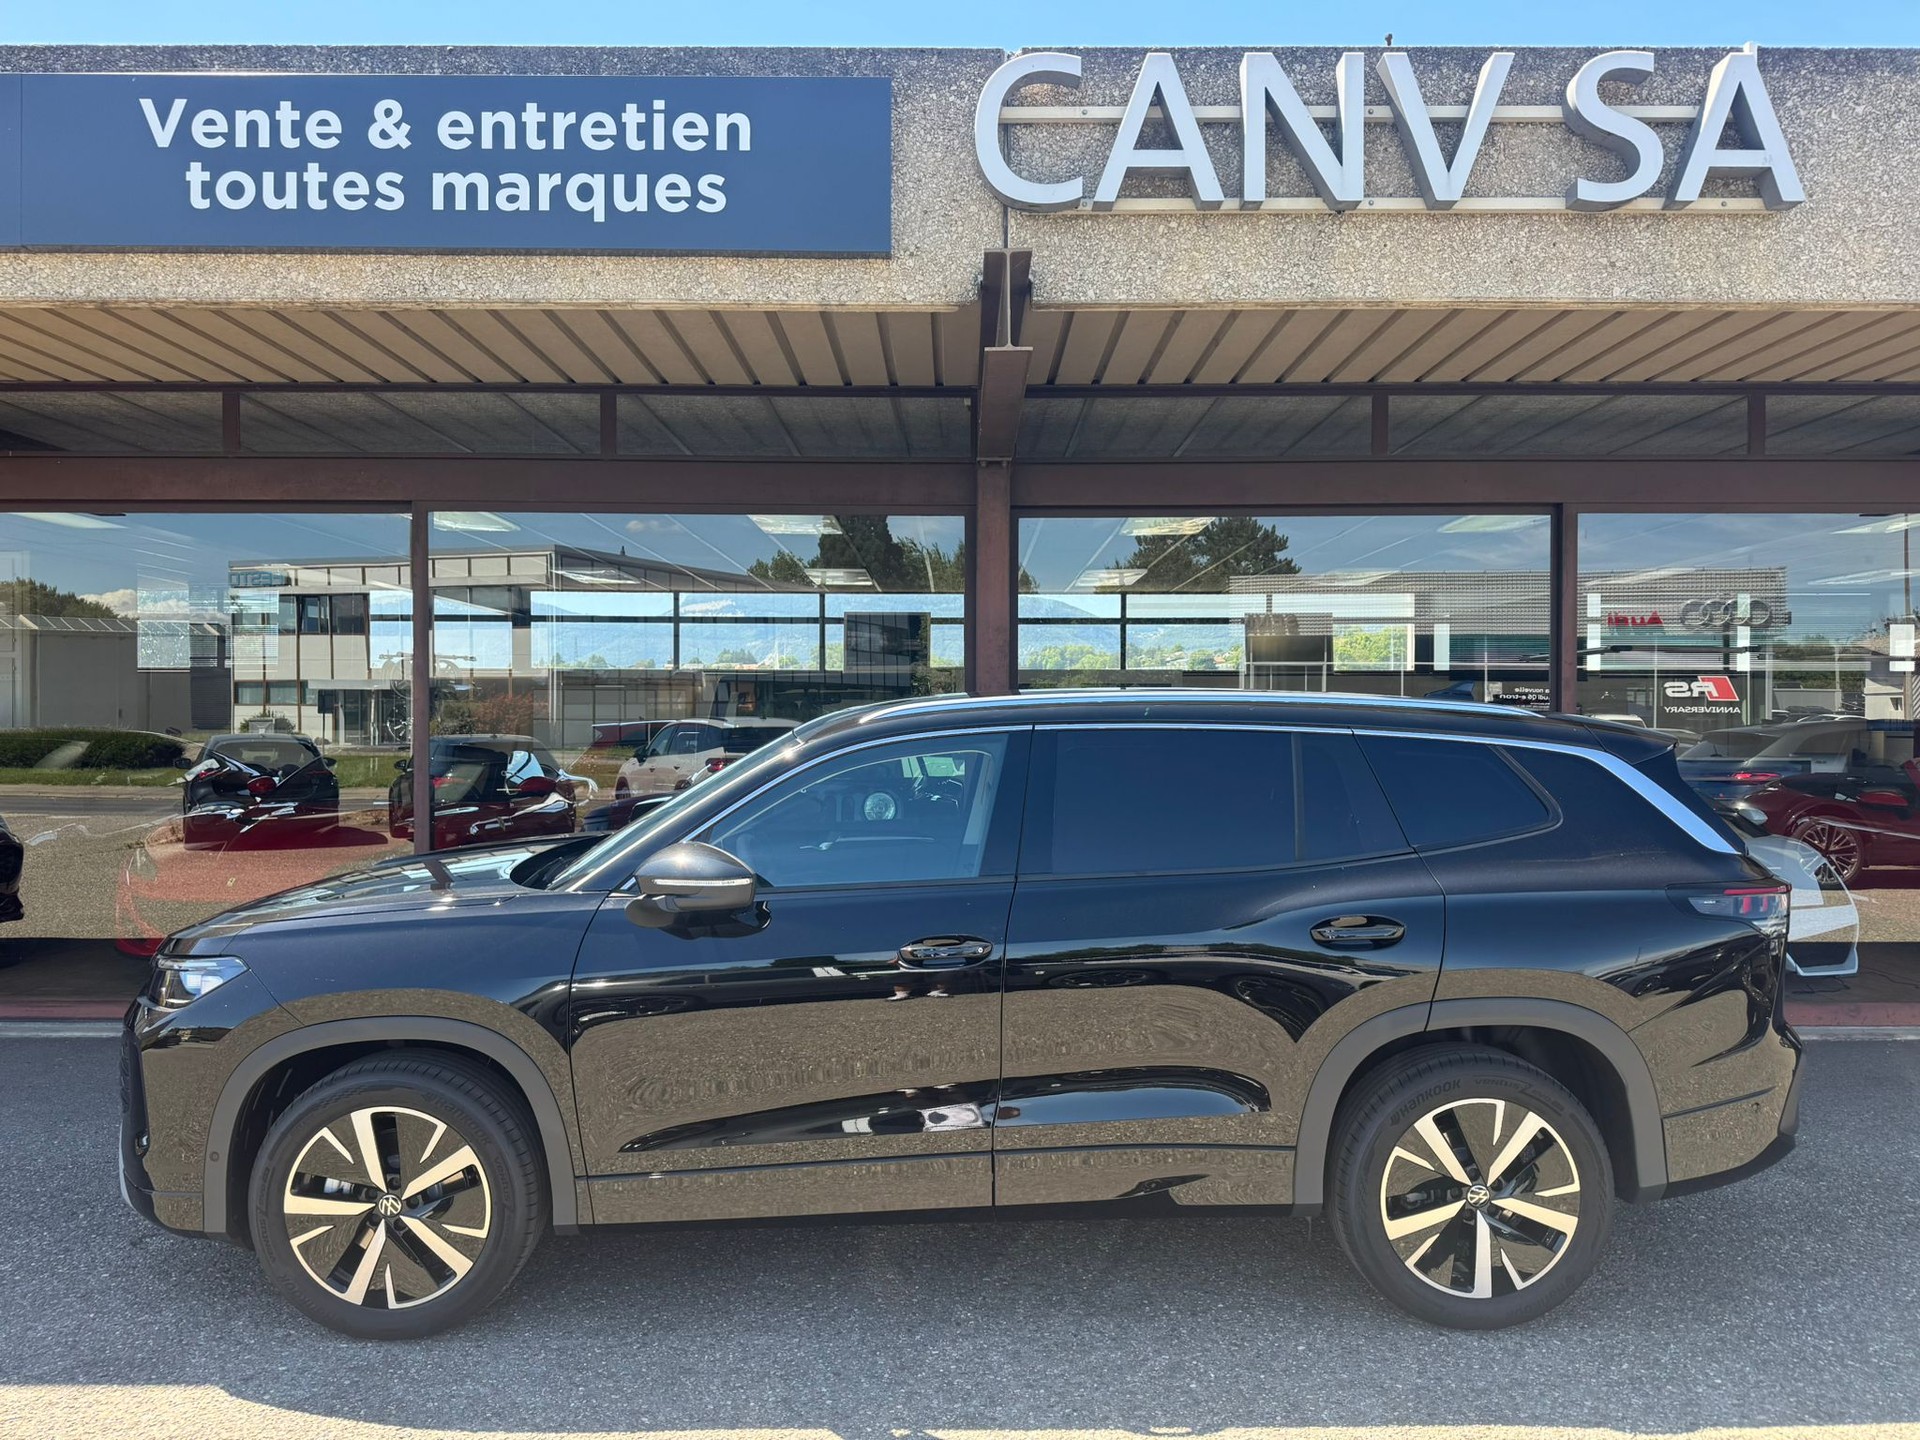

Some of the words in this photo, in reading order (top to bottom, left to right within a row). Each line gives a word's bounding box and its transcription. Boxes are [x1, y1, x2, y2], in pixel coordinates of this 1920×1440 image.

[140, 98, 341, 149] Vente
[368, 99, 411, 150] &
[437, 99, 751, 151] entretien
[974, 51, 1514, 211] CANV
[1566, 46, 1806, 211] SA
[186, 161, 405, 211] toutes
[432, 172, 727, 223] marques
